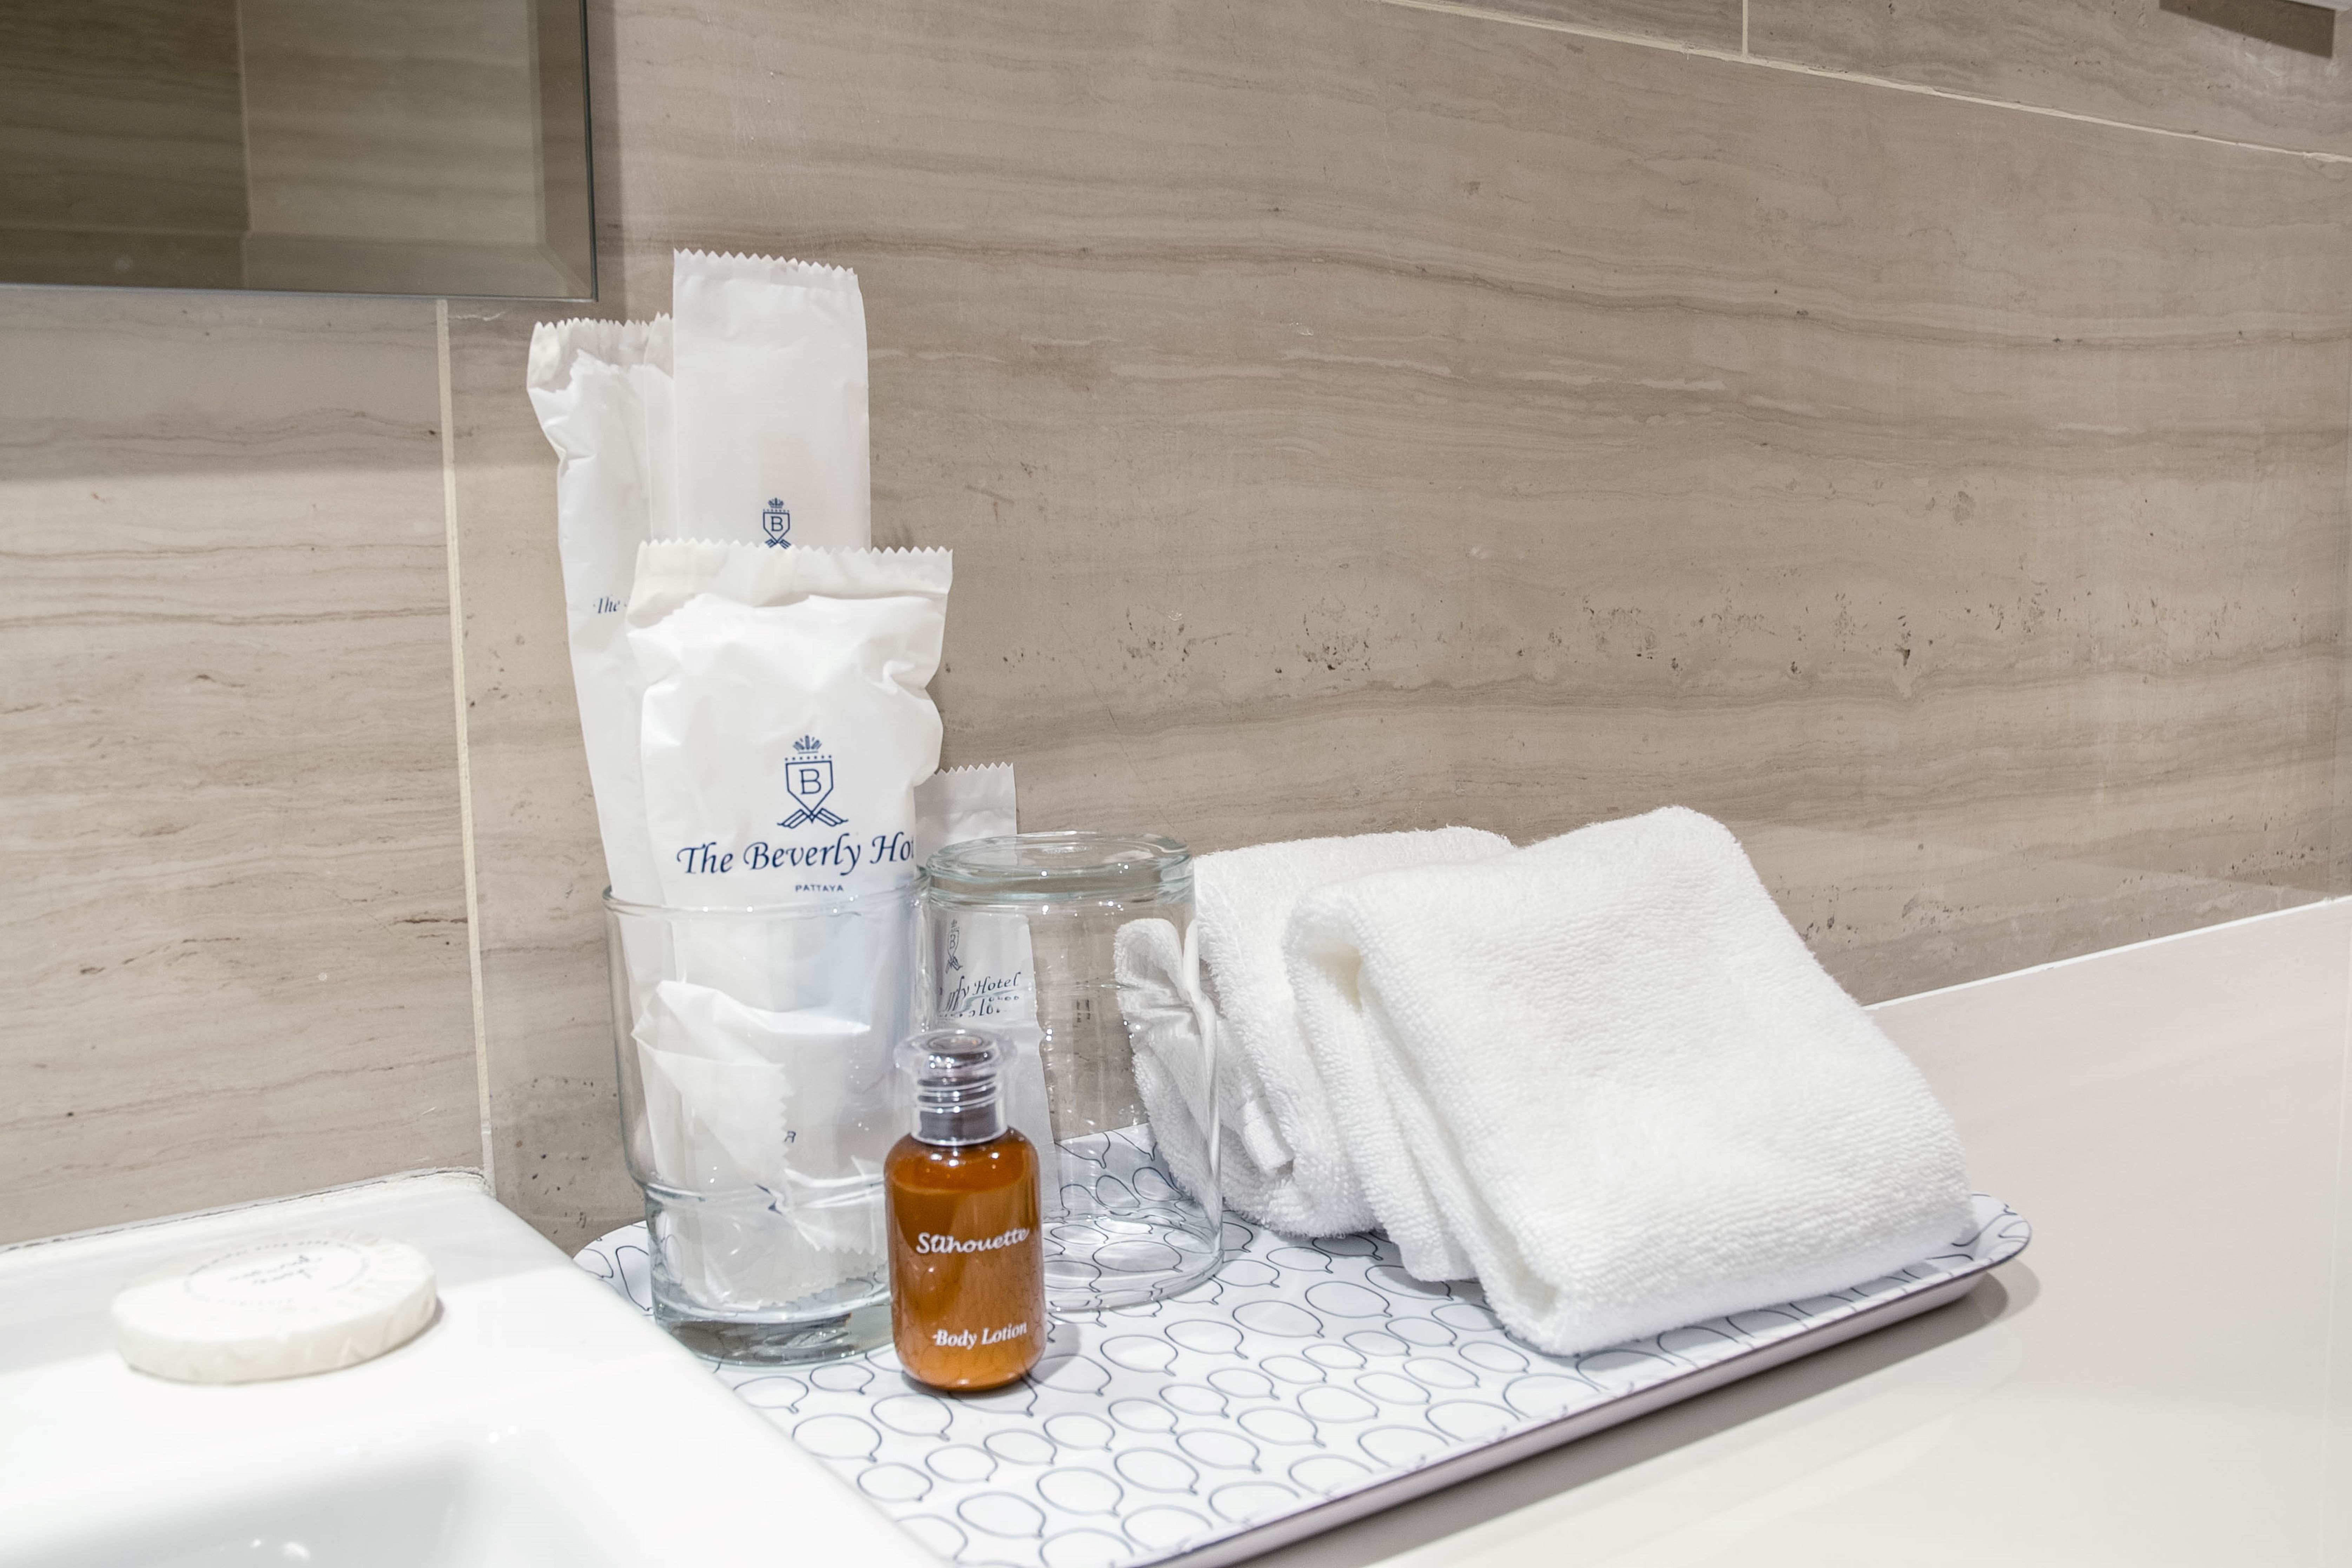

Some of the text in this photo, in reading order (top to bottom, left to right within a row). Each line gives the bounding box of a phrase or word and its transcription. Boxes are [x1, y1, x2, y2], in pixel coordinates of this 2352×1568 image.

[771, 516, 783, 531] B
[800, 769, 821, 794] B
[676, 831, 914, 876] The Beverly Ho
[972, 972, 1021, 995] Hotel
[936, 1322, 1027, 1350] Body Lotion
